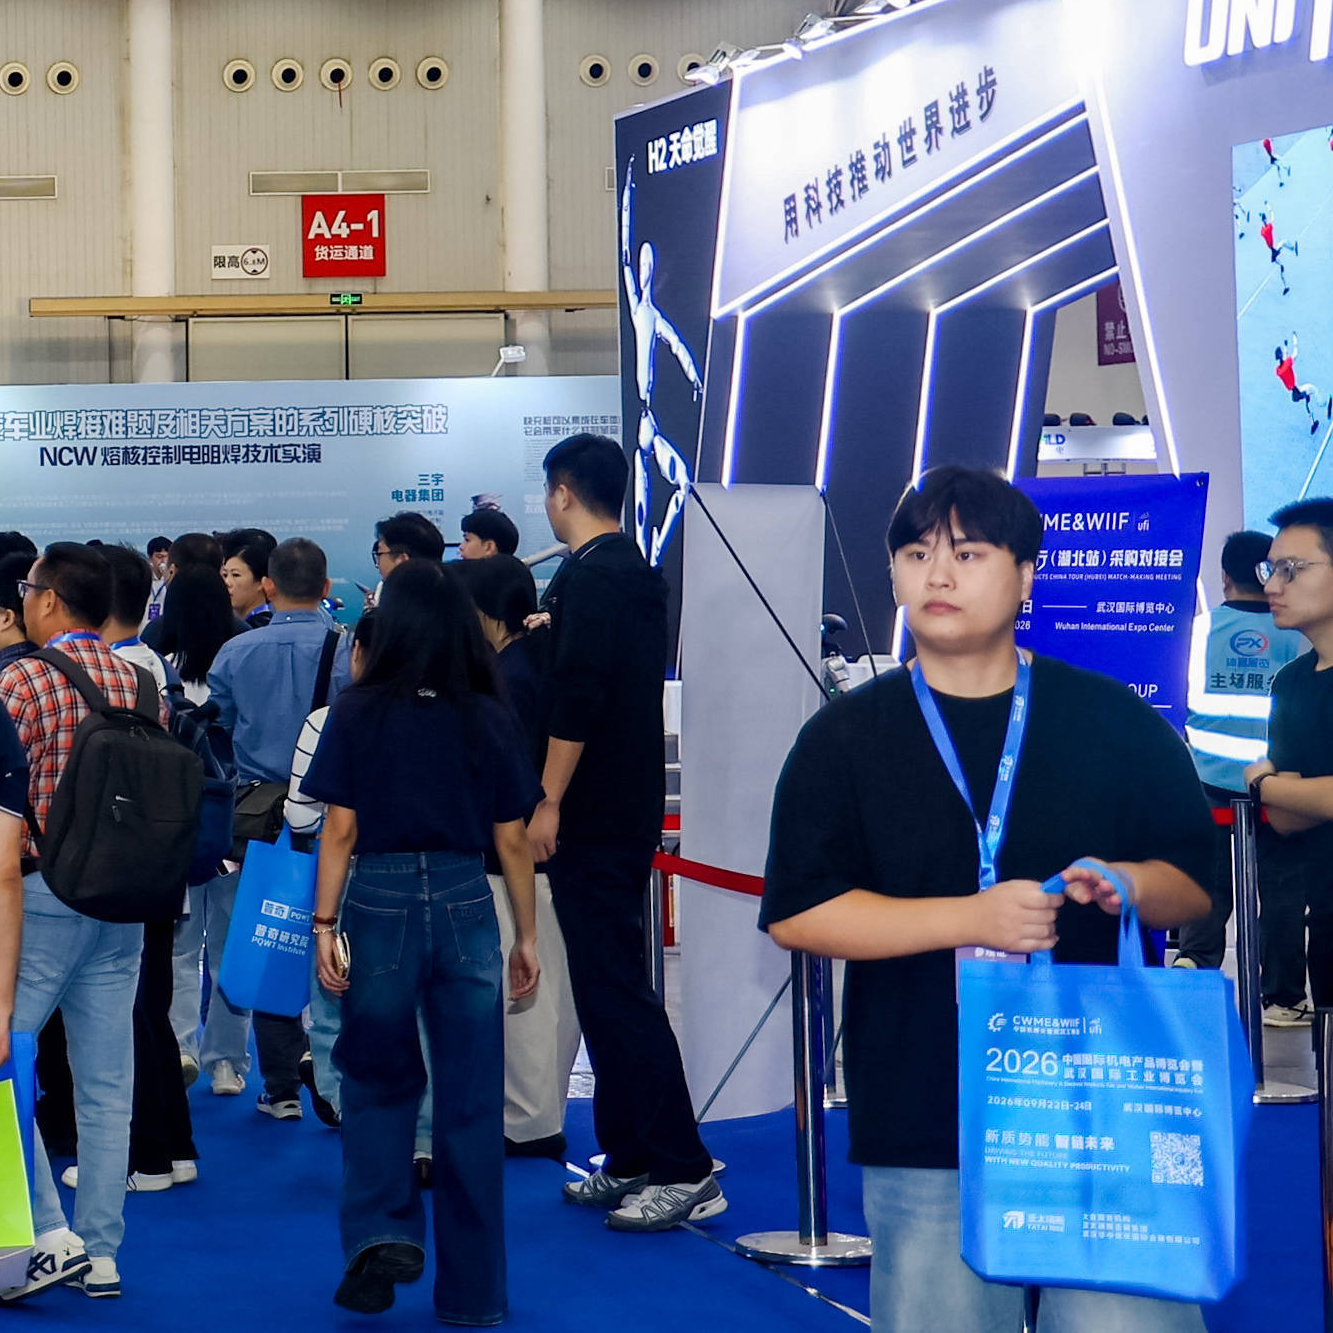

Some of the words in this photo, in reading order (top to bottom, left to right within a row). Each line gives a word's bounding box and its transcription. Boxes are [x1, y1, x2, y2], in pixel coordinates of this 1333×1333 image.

[647, 137, 668, 175] H2
[668, 119, 718, 171] 天命觉醒
[783, 65, 999, 244] 用科技推动世界进步
[307, 210, 381, 240] A4-1
[213, 254, 240, 269] 限高
[314, 244, 374, 261] 货运通道
[39, 445, 98, 467] NCW
[101, 443, 323, 466] 熔核控制电阻焊技术实演
[417, 473, 445, 487] 三宇
[391, 488, 445, 503] 电器集团
[1040, 512, 1130, 531] ME&WIIF
[1137, 520, 1150, 531] ufi
[1096, 601, 1175, 614] 武汉国际博览中心
[1014, 620, 1031, 630] 026
[1055, 622, 1080, 631] Wuhan
[1081, 622, 1127, 632] International
[1128, 623, 1148, 633] Expo
[1149, 623, 1175, 632] Center
[1013, 1016, 1080, 1027] CWME&WIIF
[986, 1047, 1059, 1077] 2026
[1064, 1067, 1203, 1086] 武汉国际工业博览会
[985, 1128, 1050, 1147] 新质势能
